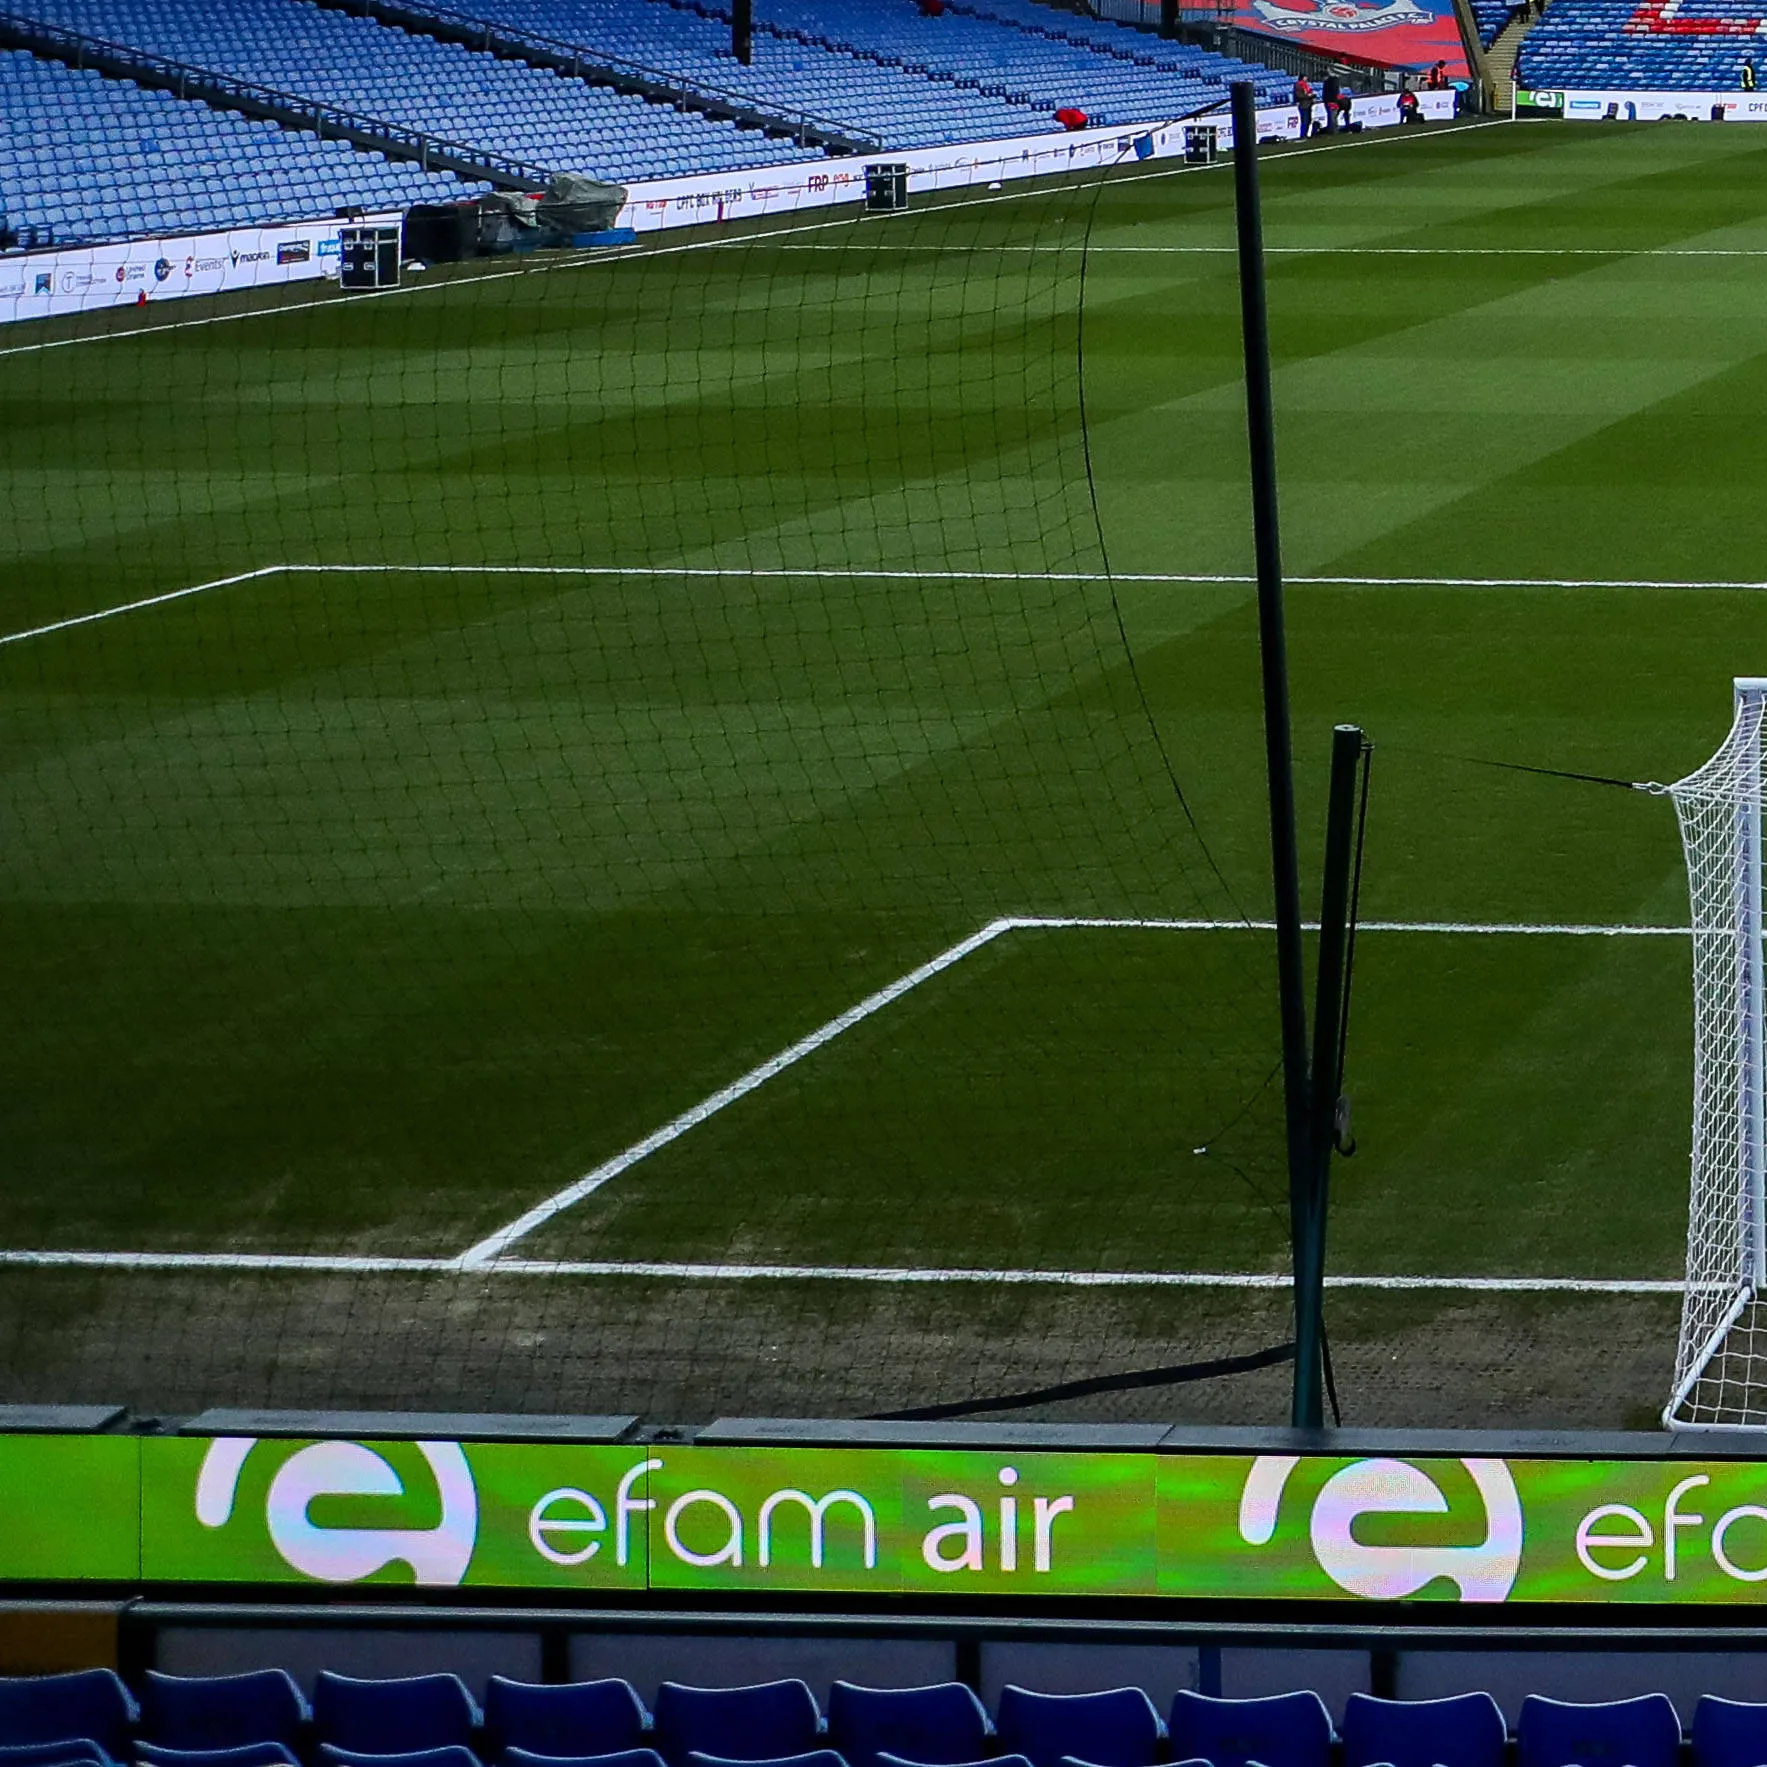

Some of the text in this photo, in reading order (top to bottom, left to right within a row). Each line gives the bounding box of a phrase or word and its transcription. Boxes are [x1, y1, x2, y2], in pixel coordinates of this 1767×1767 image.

[1276, 17, 1346, 30] CRYSTAL
[1350, 14, 1398, 30] PALACE
[808, 174, 829, 193] FRP
[529, 1460, 1073, 1572] efam air
